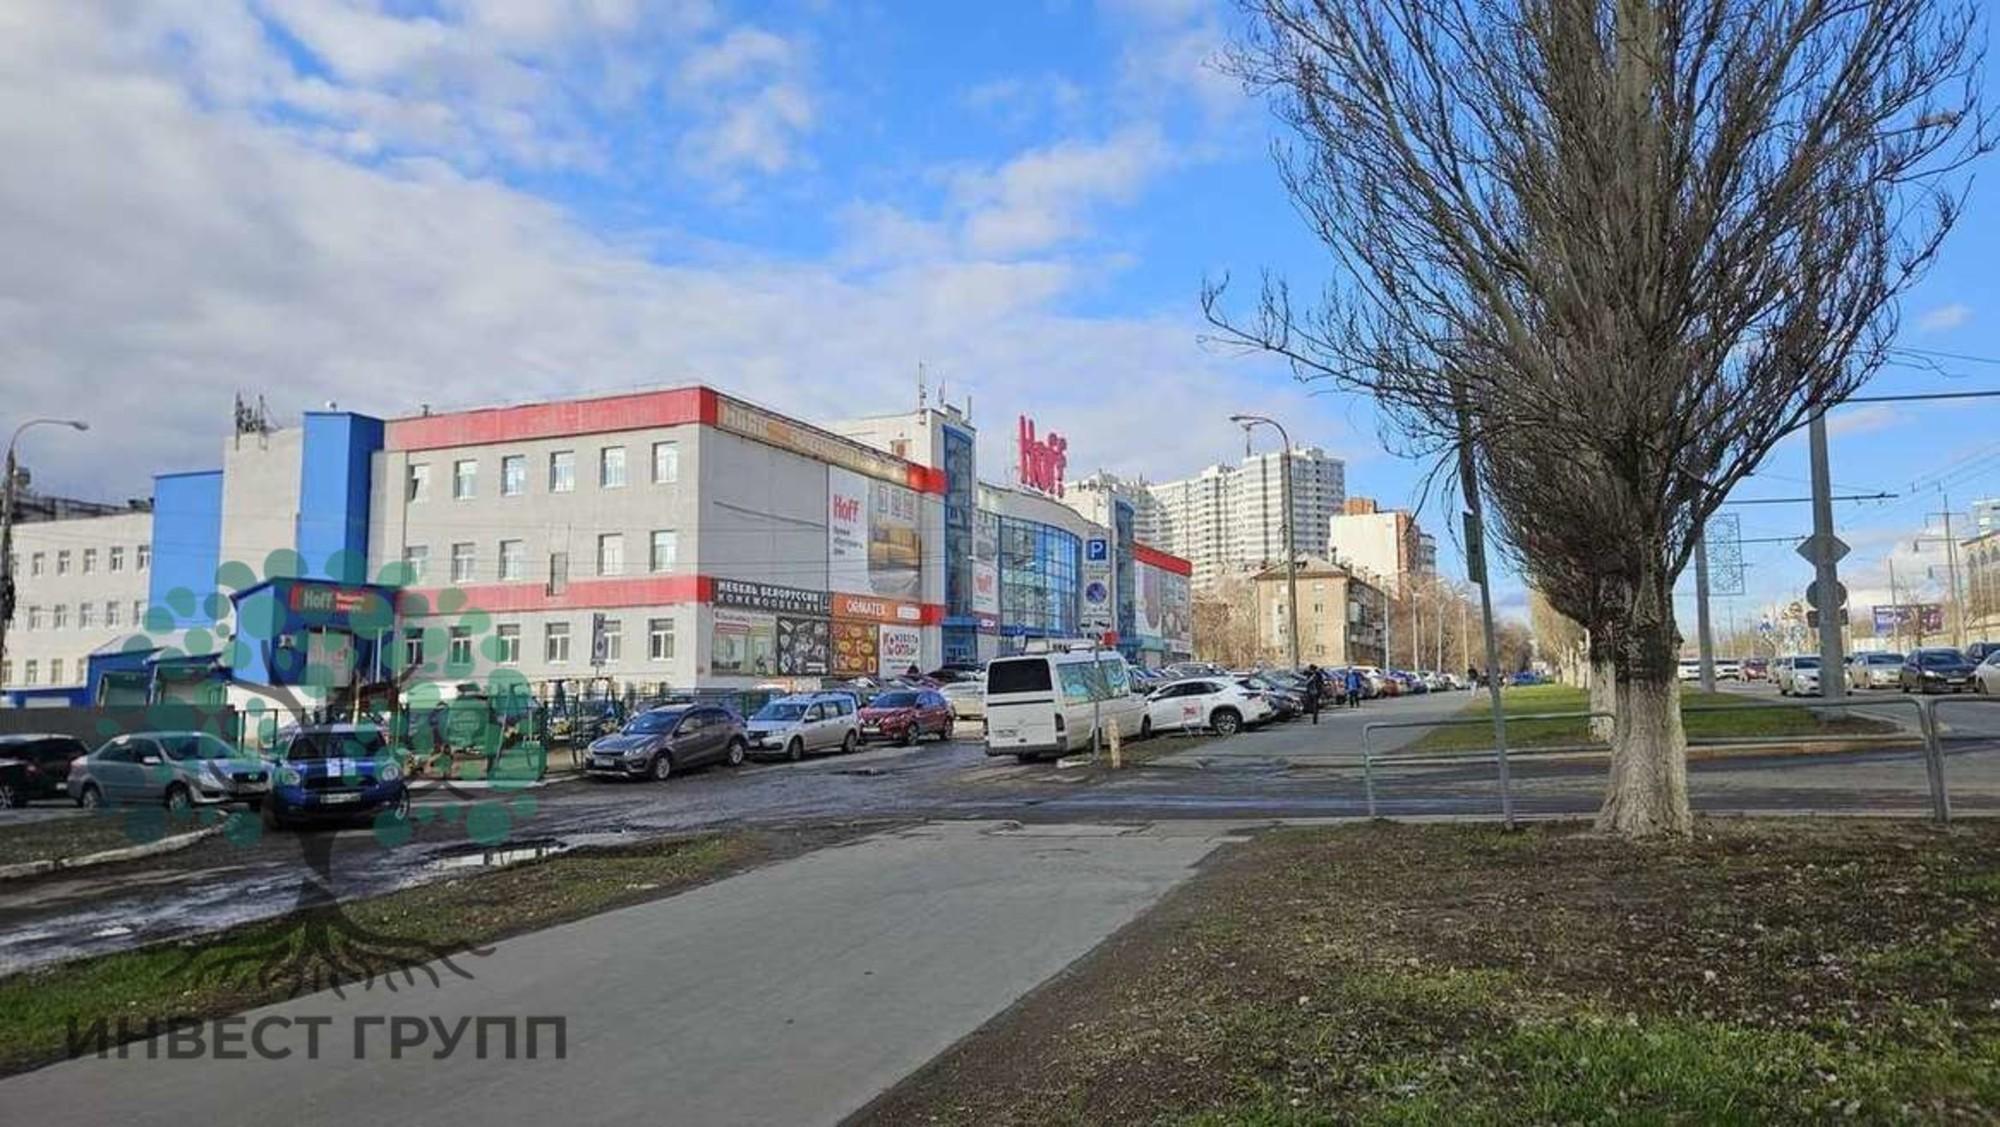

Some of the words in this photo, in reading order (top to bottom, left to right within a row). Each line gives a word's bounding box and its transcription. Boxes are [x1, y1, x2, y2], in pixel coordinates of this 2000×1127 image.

[1019, 414, 1067, 498] Hoff
[833, 494, 859, 522] Hoff
[303, 590, 333, 610] Hoff
